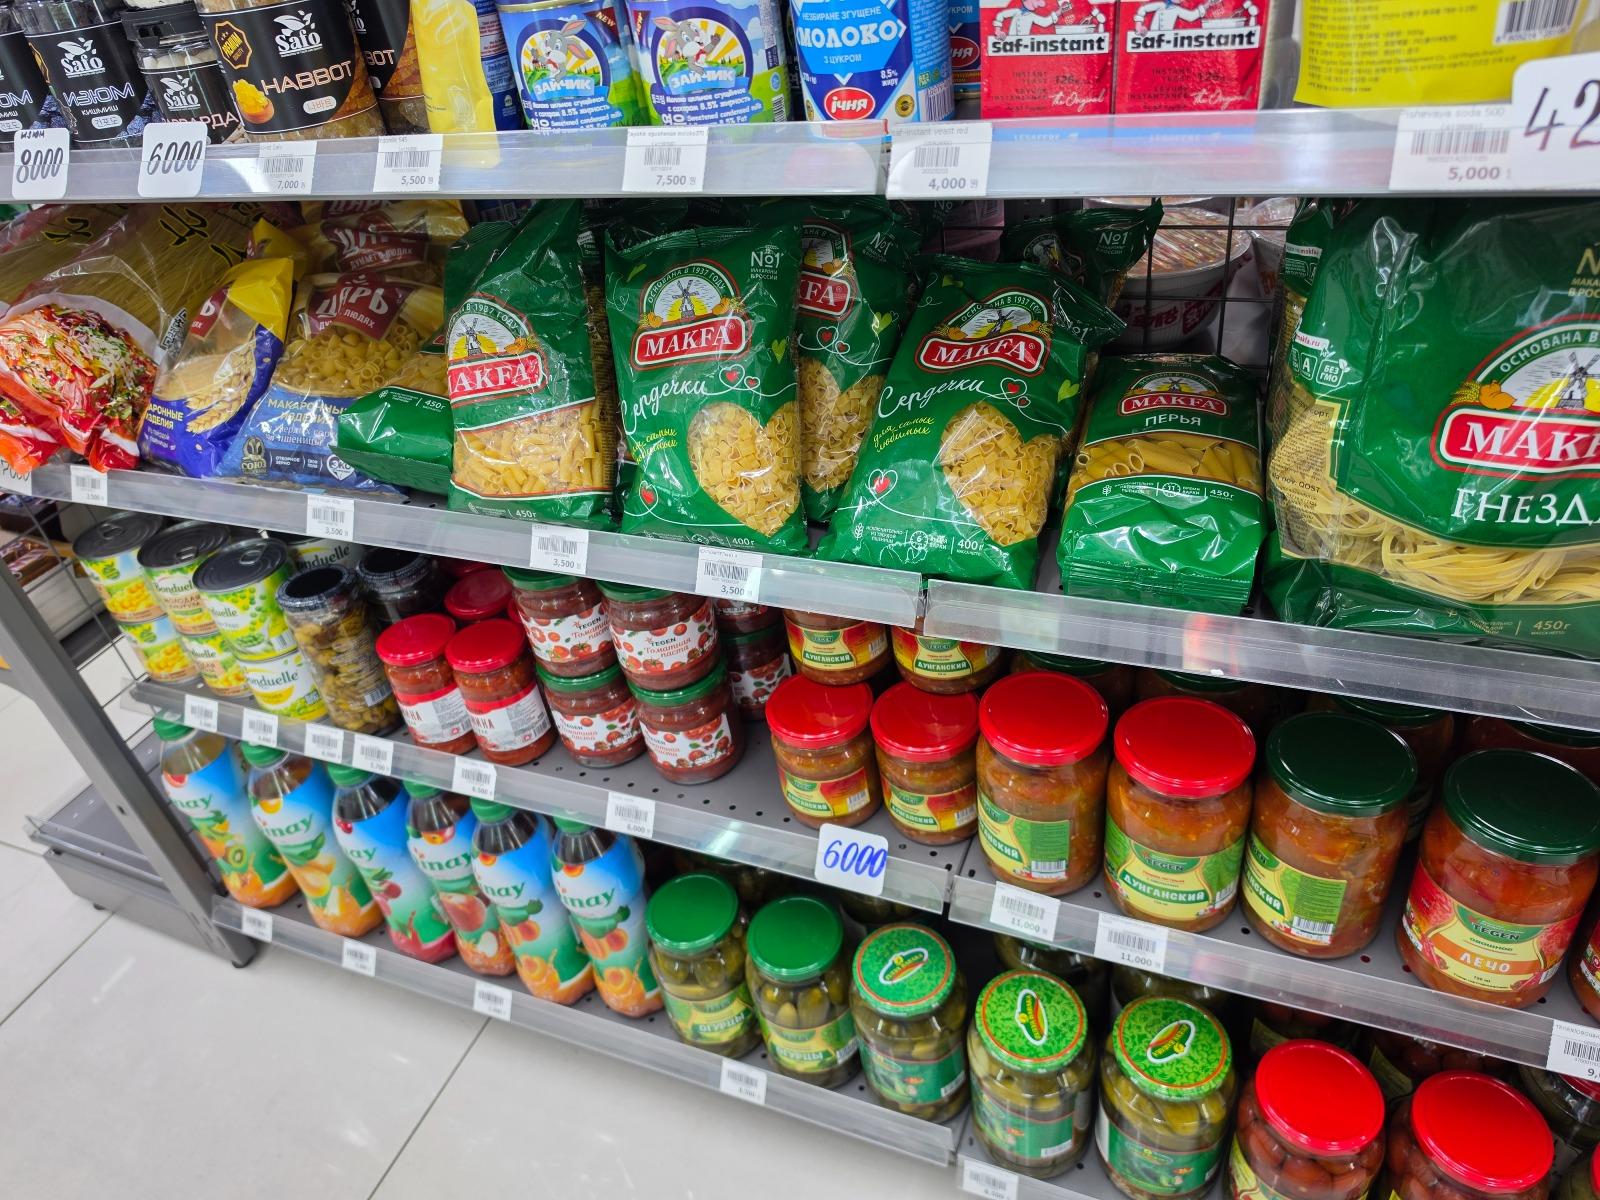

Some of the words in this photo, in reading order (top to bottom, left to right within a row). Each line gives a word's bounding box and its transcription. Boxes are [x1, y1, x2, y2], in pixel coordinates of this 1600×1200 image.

[595, 11, 617, 28] NEW
[842, 6, 882, 20] ЗГУЩЕНЕ
[275, 29, 322, 53] Safo
[798, 20, 898, 48] МОЛОКО
[1131, 30, 1256, 50] saf-instant
[992, 36, 1105, 53] saf-instant
[60, 54, 103, 74] Safo
[363, 49, 395, 66] ВОТ
[830, 54, 862, 65] ЦУКРОМ
[534, 77, 591, 95] ЗАЙЧИК
[670, 69, 735, 88] ЗАЙЧИК
[62, 82, 136, 107] ИЗЮМ
[163, 91, 200, 108] Safo
[81, 105, 119, 116] КИШМИШ
[831, 95, 868, 113] ічня
[17, 147, 64, 184] 8000
[146, 140, 203, 176] 6000
[401, 175, 426, 186] 5,500
[656, 175, 687, 187] 7,500
[1447, 166, 1501, 181] 5,000
[277, 179, 300, 190] 7,000
[928, 177, 966, 191] 4,000
[648, 270, 683, 304] ОСНОВАНА
[692, 266, 709, 276] 1937
[709, 272, 726, 290] ГОДУ
[316, 286, 390, 319] ЦАРЬ
[961, 299, 1005, 322] ОСНОНА
[1014, 296, 1030, 305] 1937
[344, 308, 376, 329] ЛЮДЯХ
[496, 312, 519, 330] ГОДУ
[645, 325, 733, 357] MAKFA
[931, 338, 1028, 364] MAKFA
[1499, 331, 1582, 373] ОСНОВАНА
[451, 363, 528, 393] AKFA
[1320, 372, 1338, 383] ГМО
[1323, 365, 1340, 375] БЕЗ
[621, 377, 708, 436] Сердечки
[878, 377, 985, 419] Сердечки
[1131, 395, 1217, 410] MAKFA
[1145, 413, 1201, 426] ПЕРЬЯ
[241, 461, 267, 470] СОЮЗ
[553, 558, 575, 568] 3,500
[154, 578, 194, 594] Bonduel
[720, 584, 745, 596] 3,500
[578, 616, 601, 630] TEGEN
[644, 637, 691, 654] Томатная
[651, 637, 676, 646] TEGEN
[660, 645, 690, 658] паста
[804, 652, 851, 664] ДУНГАНСКИЙ
[917, 660, 968, 670] ДУНГАНСКИЙ
[421, 851, 471, 872] inay
[823, 840, 888, 878] 6000
[1146, 859, 1184, 871] TEGEN
[1124, 873, 1205, 902] ДУНГАНСКИЙ
[563, 887, 616, 910] inay
[1011, 917, 1041, 933] 11,000
[1471, 921, 1521, 941] TEGEN
[1470, 937, 1513, 952] ОВОЩНОЕ
[1120, 952, 1153, 967] 11,000
[1460, 952, 1511, 973] ЛЕЧО
